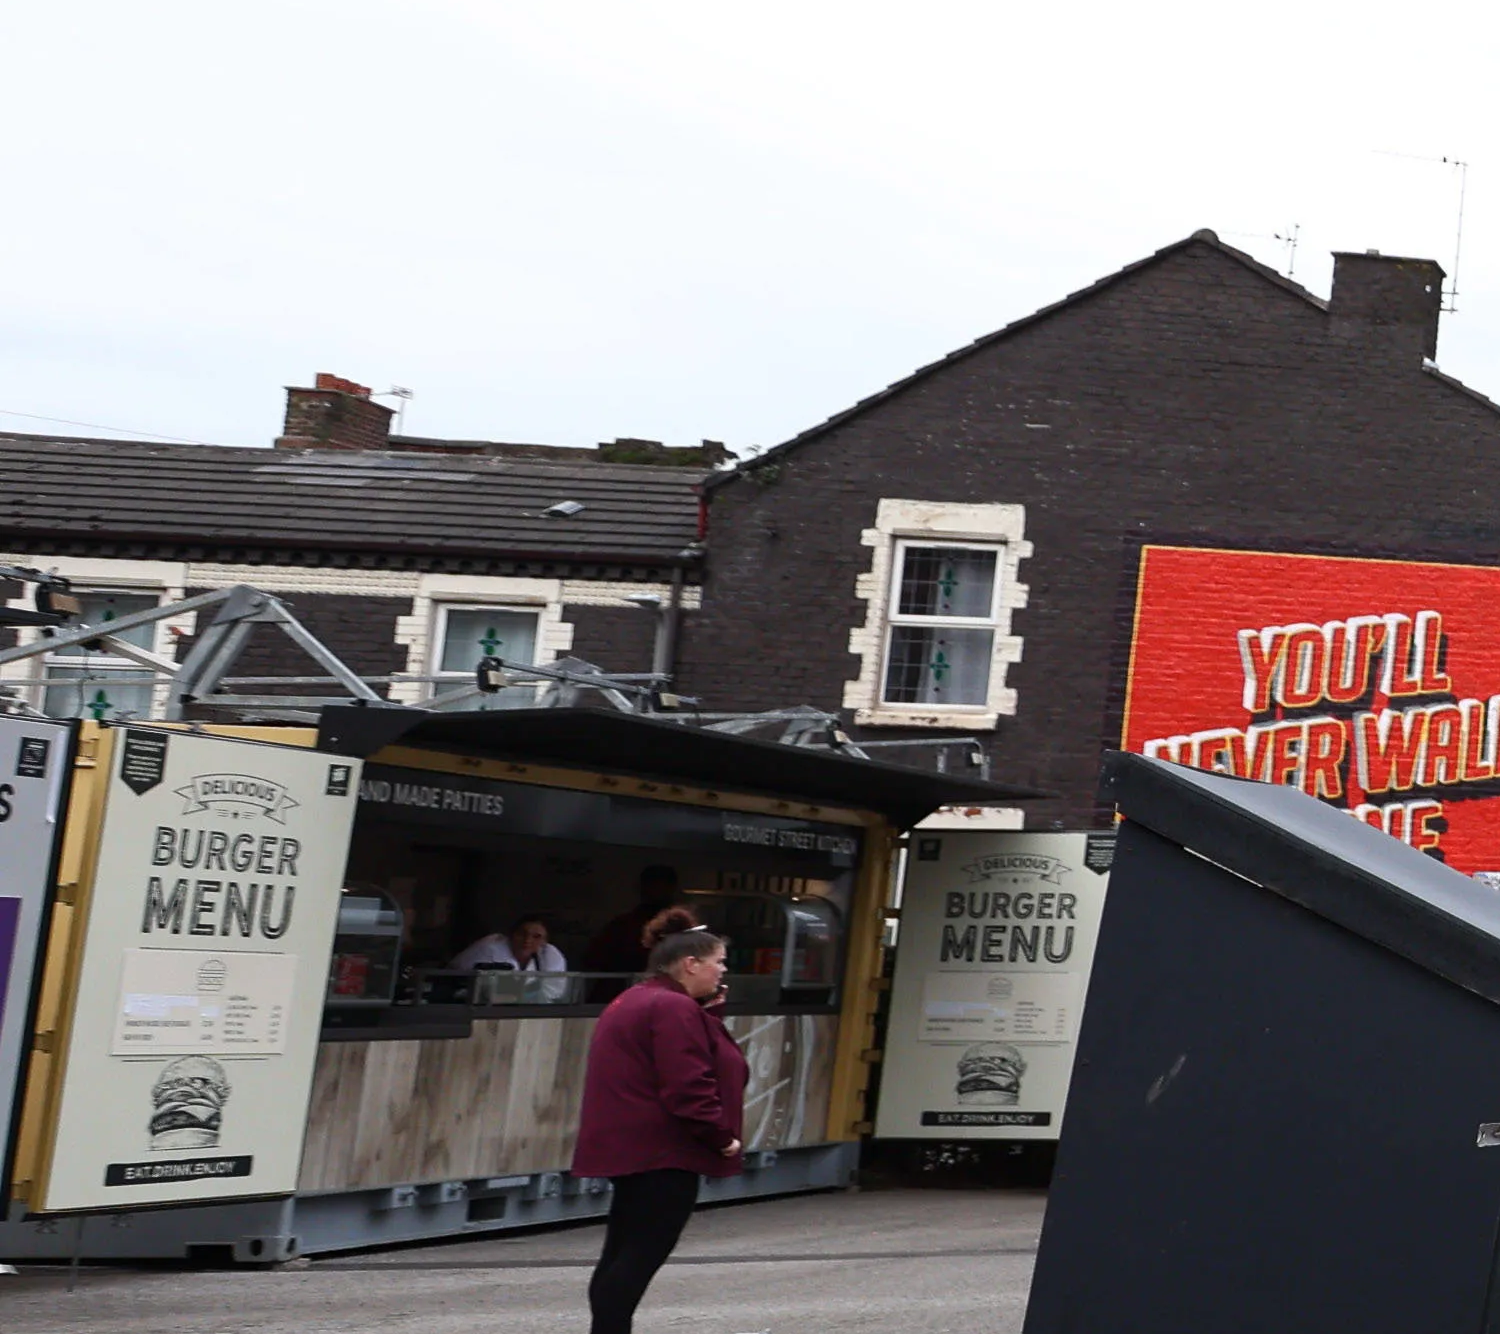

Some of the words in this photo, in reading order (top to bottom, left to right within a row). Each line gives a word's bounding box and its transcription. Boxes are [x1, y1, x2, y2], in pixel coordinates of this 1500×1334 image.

[1237, 610, 1455, 712] YOU'LL
[201, 779, 278, 802] DELICIOUS
[360, 779, 390, 802] AND
[393, 783, 440, 809] MADE
[443, 788, 504, 816] PATTIES
[152, 826, 302, 877] BURGER
[778, 829, 814, 851] STREET
[983, 857, 1050, 871] DELICIOUS
[141, 876, 297, 940] MENU
[945, 892, 1078, 919] BURGER
[939, 925, 1075, 964] MENU
